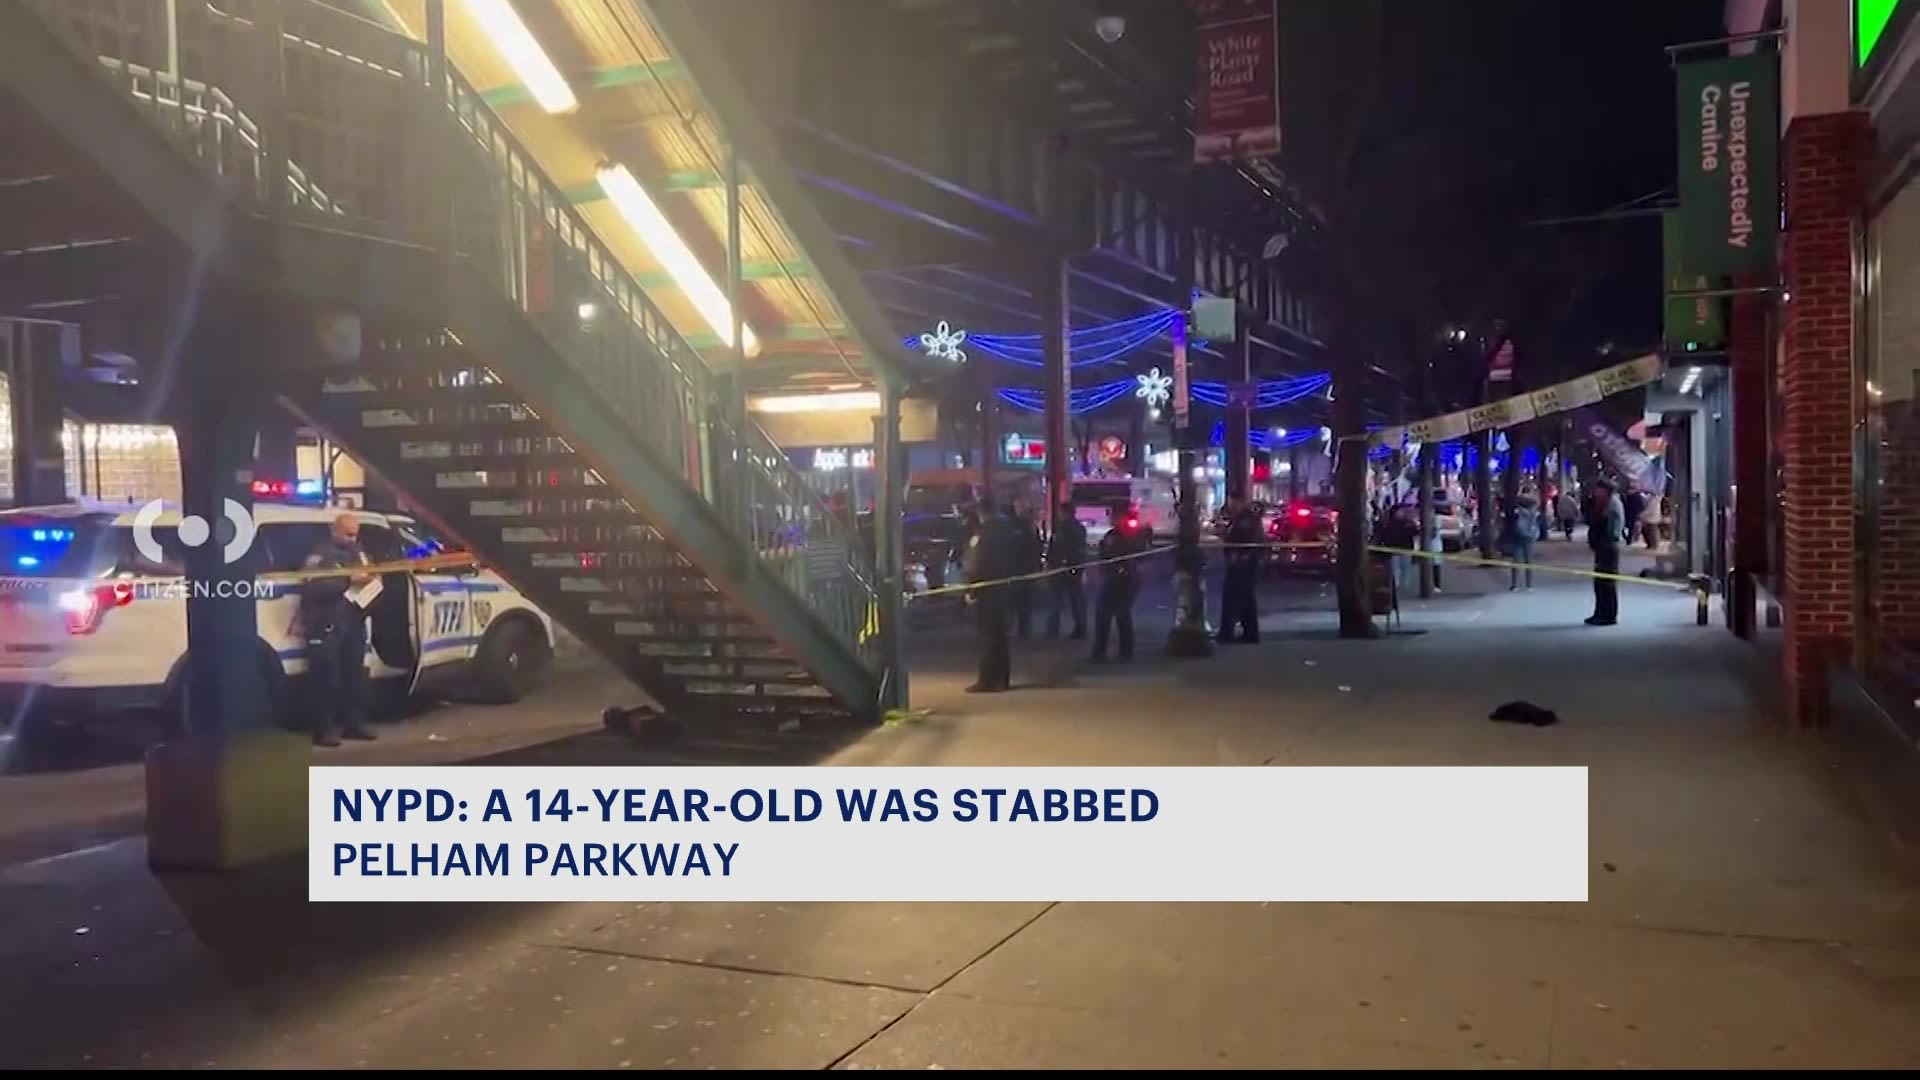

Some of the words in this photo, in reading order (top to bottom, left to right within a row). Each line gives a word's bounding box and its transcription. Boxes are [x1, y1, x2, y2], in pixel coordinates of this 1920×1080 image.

[1209, 35, 1260, 53] White
[1210, 66, 1253, 87] Road
[1702, 85, 1723, 171] Canine
[1727, 82, 1753, 248] Unexpectedly
[431, 600, 466, 636] NYPD
